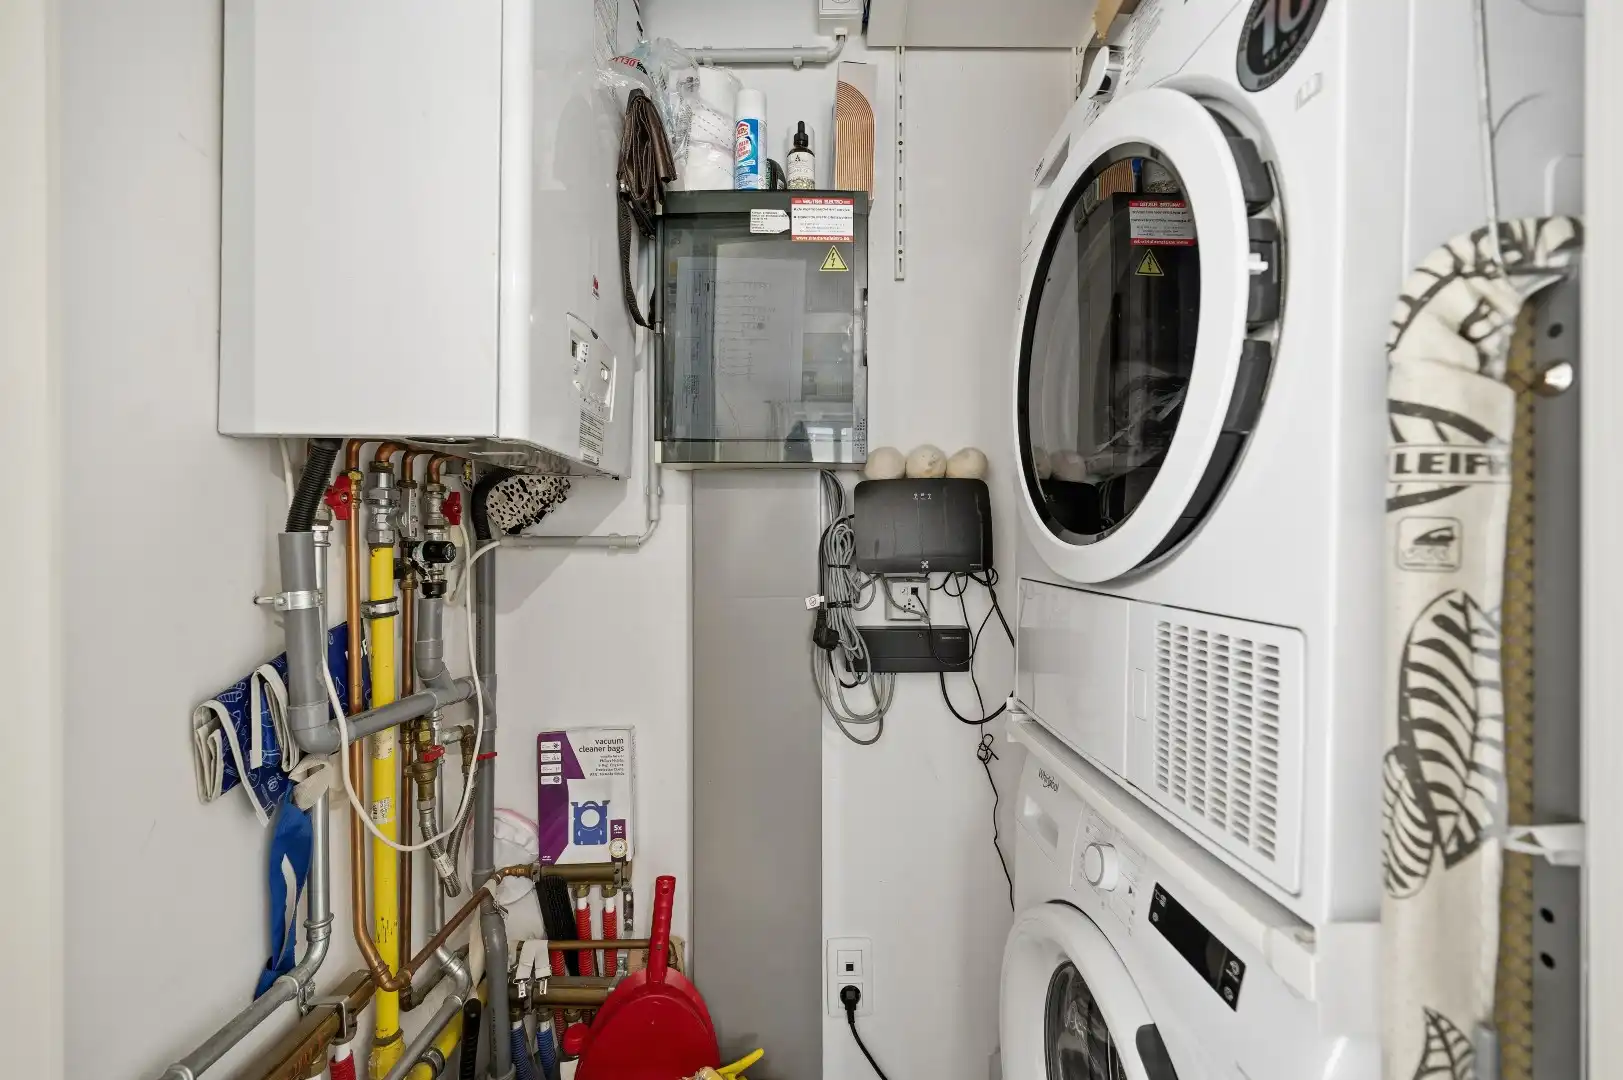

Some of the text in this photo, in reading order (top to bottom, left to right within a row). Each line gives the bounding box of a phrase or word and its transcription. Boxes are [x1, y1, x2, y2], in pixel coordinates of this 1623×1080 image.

[1394, 452, 1508, 475] LEIF
[578, 744, 625, 754] cleaner bags
